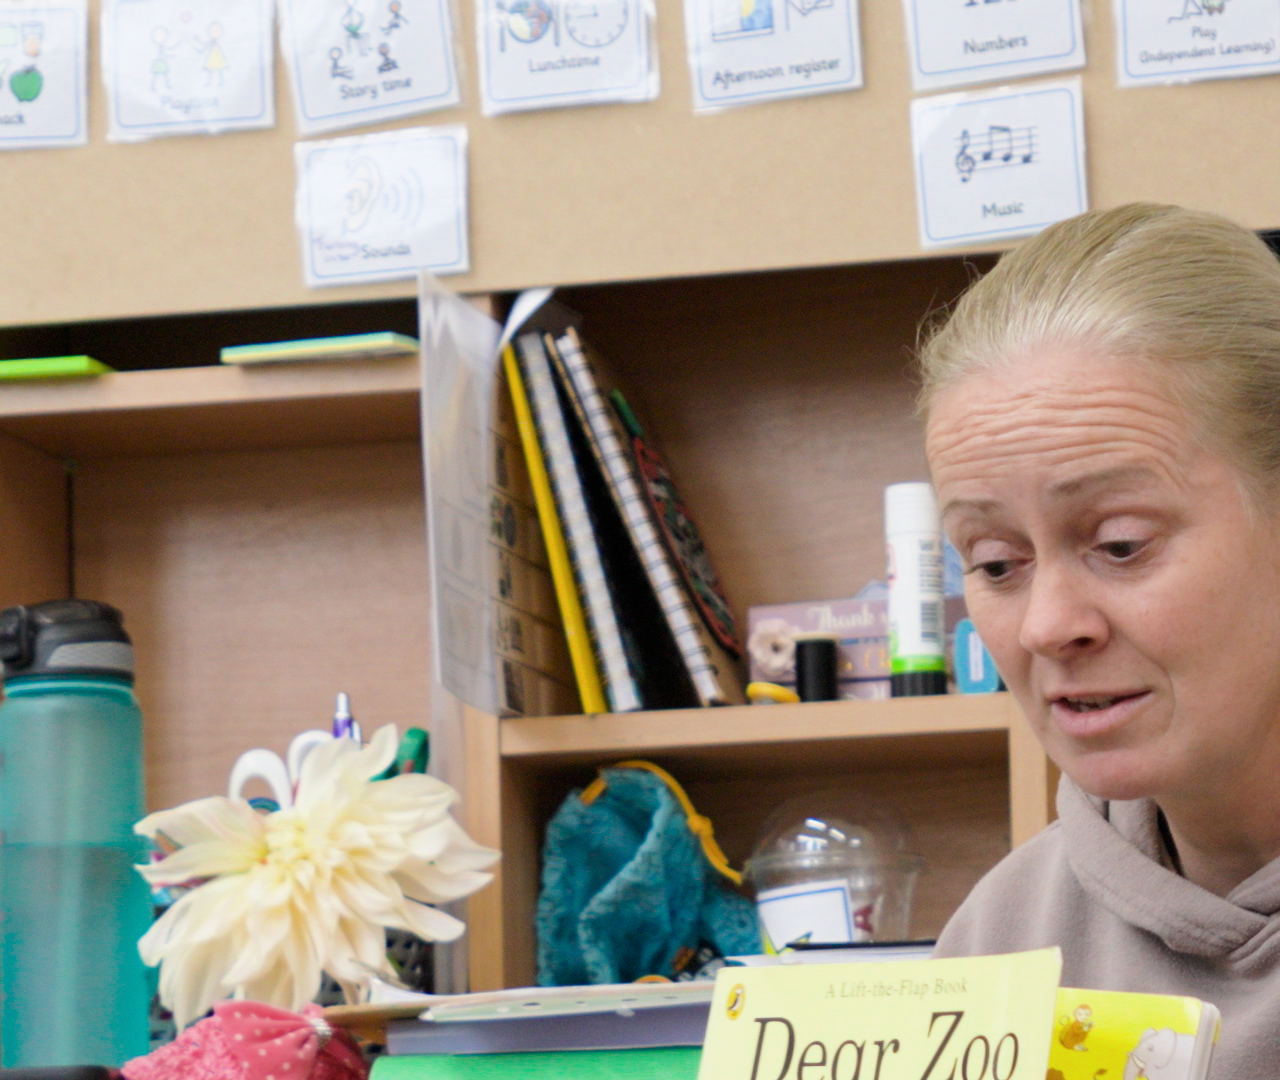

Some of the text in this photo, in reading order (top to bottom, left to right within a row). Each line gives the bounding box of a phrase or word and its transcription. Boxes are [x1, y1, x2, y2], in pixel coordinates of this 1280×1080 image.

[1191, 26, 1217, 40] Play
[963, 34, 1028, 54] Numbers
[528, 55, 600, 73] Lunchtime
[712, 56, 841, 90] Afternoon register
[339, 84, 378, 100] Story
[981, 200, 1025, 219] Music
[825, 977, 969, 999] A Lift-the-Flap Book
